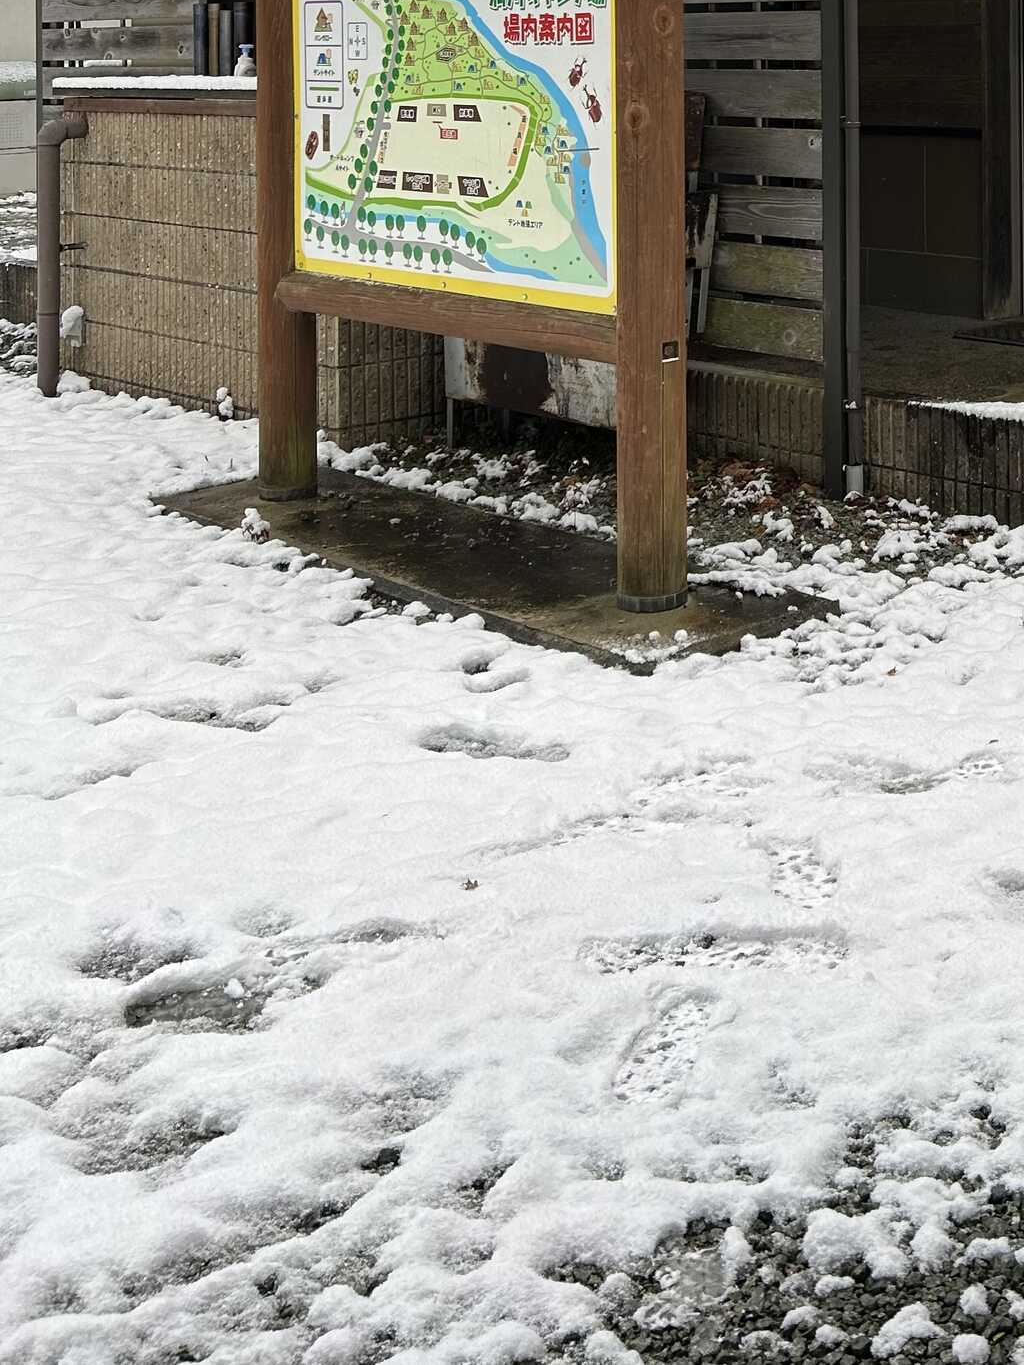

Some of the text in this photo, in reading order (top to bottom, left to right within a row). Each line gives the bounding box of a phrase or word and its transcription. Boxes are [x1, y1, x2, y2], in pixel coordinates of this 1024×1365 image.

[504, 12, 594, 45] 場内案内図
